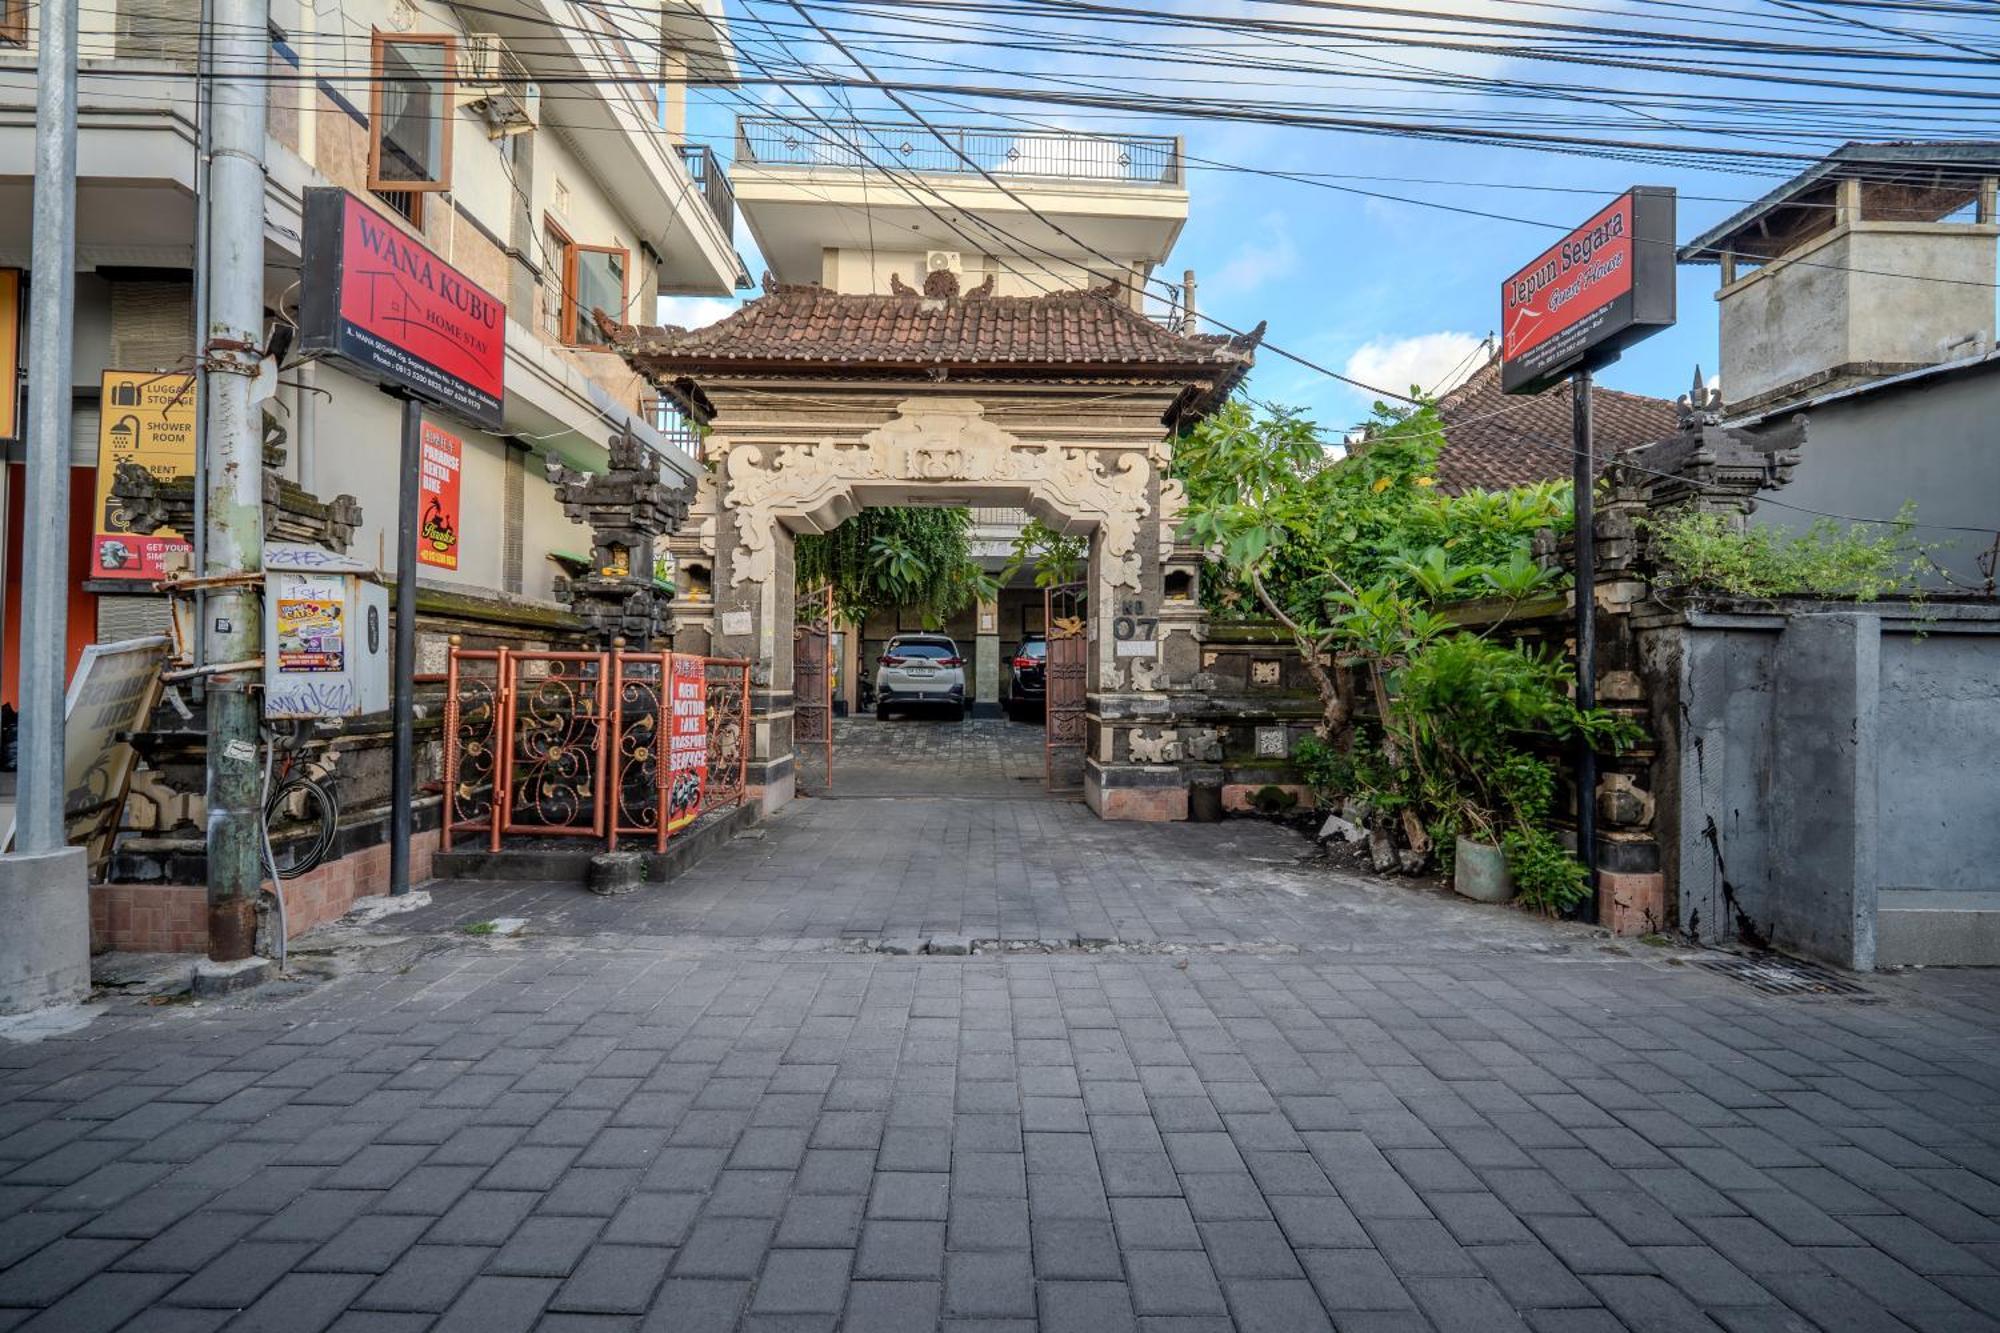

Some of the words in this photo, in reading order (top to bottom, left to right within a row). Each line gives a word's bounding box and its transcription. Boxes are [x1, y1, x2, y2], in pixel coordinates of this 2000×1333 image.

[1509, 259, 1559, 308] Jepun
[1560, 210, 1624, 273] Segara
[359, 215, 434, 292] WANA
[439, 271, 497, 330] KUBU
[1547, 273, 1582, 313] Guest
[1580, 252, 1624, 290] House
[426, 309, 463, 339] HOME
[464, 332, 488, 354] STAY
[372, 352, 392, 369] Phone
[146, 395, 194, 406] STORGE
[146, 422, 192, 432] SHOWER
[151, 433, 186, 443] ROOM
[423, 444, 460, 472] PARADISE
[150, 465, 177, 475] RENT
[423, 459, 450, 483] RENTAL
[422, 474, 441, 495] BIKE
[145, 543, 163, 553] GET
[164, 543, 190, 553] YOUR
[1112, 617, 1158, 641] 07
[678, 682, 700, 699] RENT
[673, 700, 705, 716] MOTOR
[669, 749, 707, 772] SERVICE
